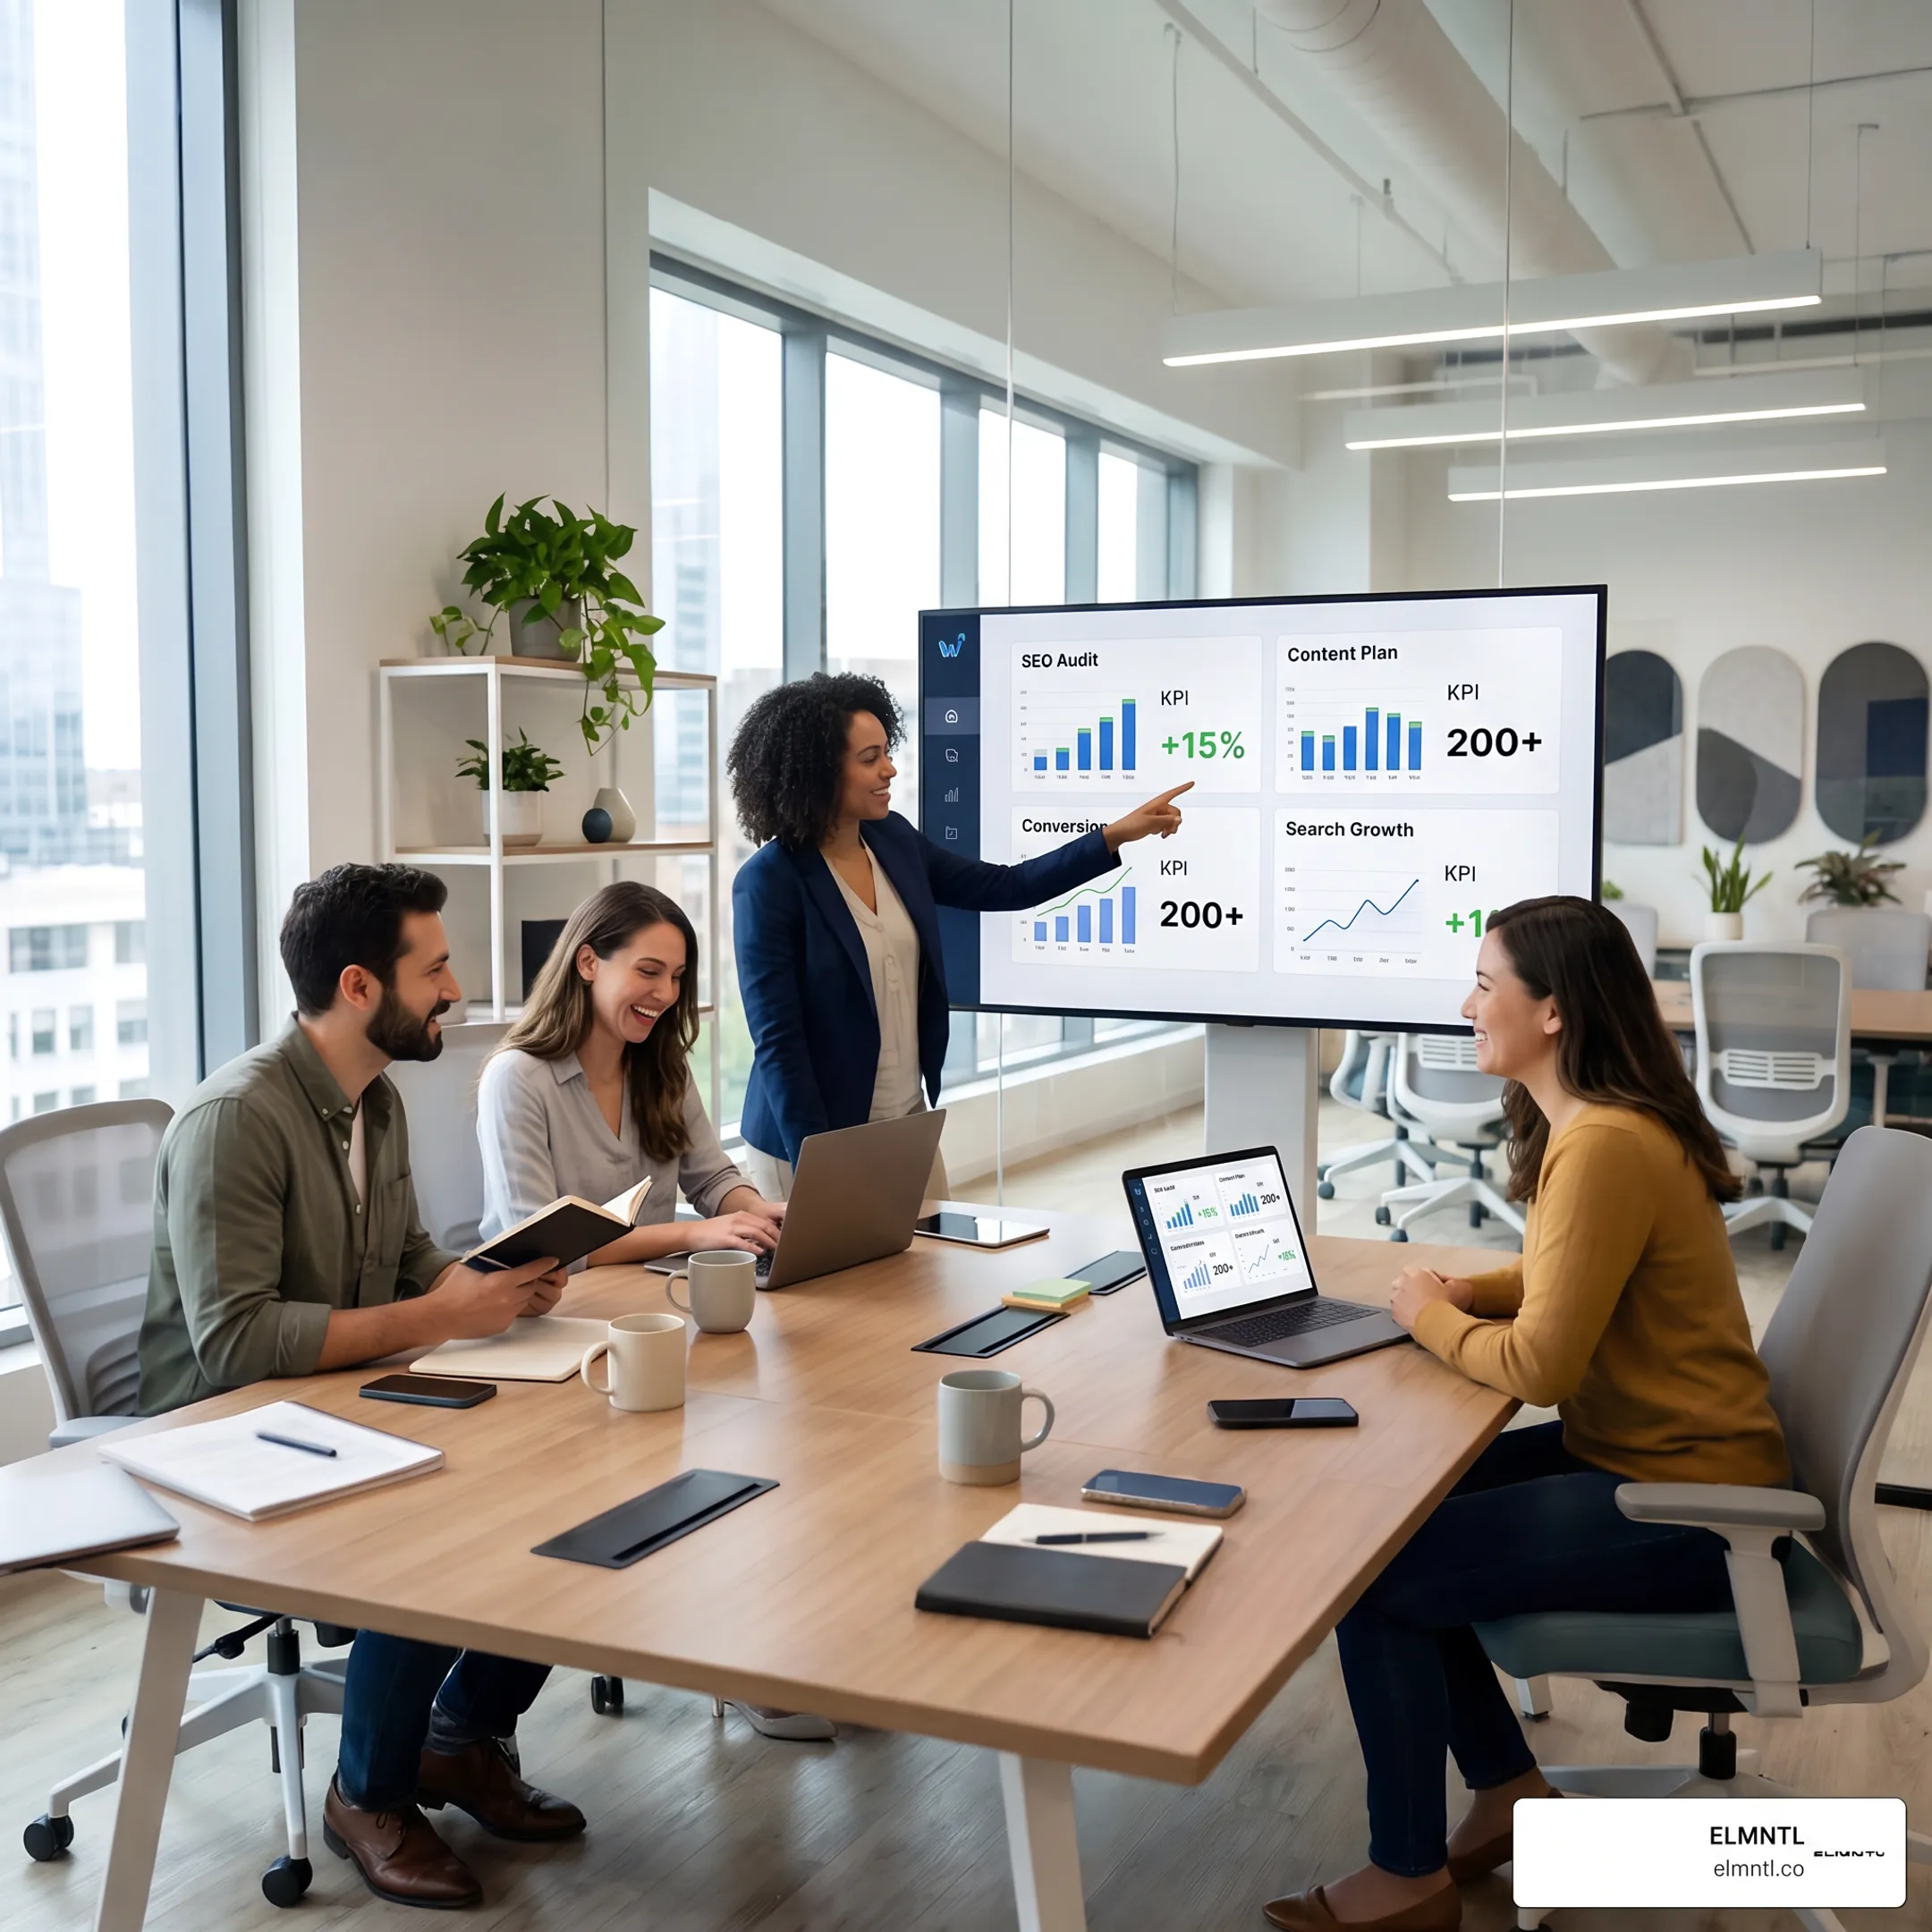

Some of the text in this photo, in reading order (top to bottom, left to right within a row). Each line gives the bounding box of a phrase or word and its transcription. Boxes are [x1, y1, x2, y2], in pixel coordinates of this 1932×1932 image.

[1021, 652, 1098, 668] SEO Audit
[1287, 645, 1398, 662] Content Plan
[1161, 690, 1189, 706] KPI
[1447, 683, 1479, 700] KPI
[1162, 731, 1245, 759] +15%
[1447, 727, 1542, 758] 200+
[1285, 821, 1414, 837] Search Growth
[1160, 860, 1188, 876] KPI
[1445, 865, 1476, 881] KPI
[1160, 901, 1243, 928] 200+
